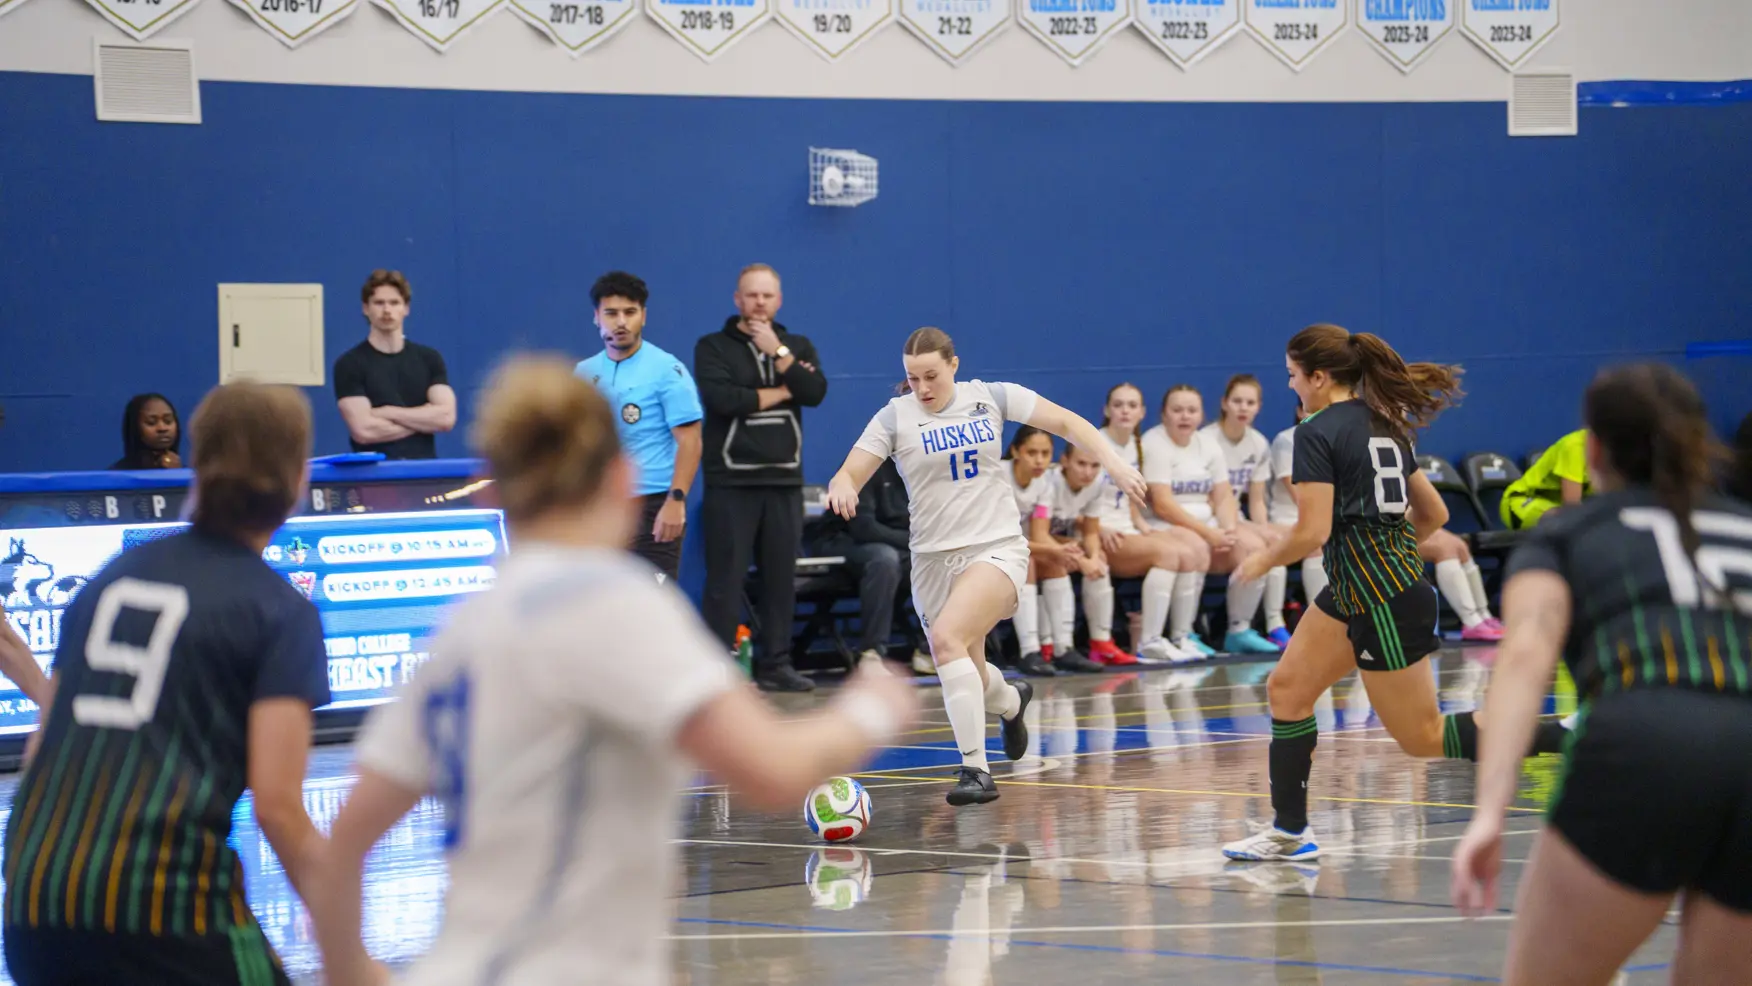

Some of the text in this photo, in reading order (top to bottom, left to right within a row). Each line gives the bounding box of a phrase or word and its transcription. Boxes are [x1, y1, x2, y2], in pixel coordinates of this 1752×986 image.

[418, 0, 460, 18] 16/17
[549, 3, 605, 25] 2017-18
[680, 10, 734, 31] 2018-19
[812, 14, 853, 33] 19/20
[937, 16, 973, 36] 21-22
[1048, 16, 1098, 36] 2022-23
[1161, 21, 1209, 40] 2022-23
[1273, 23, 1319, 41] 2023-24
[1382, 25, 1430, 43] 2023-24
[1489, 25, 1533, 43] 2023-24
[921, 418, 995, 455] HUSKIES
[949, 449, 980, 482] 15
[1367, 435, 1409, 514] 8
[105, 496, 119, 519] B
[152, 495, 167, 518] P
[322, 542, 385, 556] KICKOFF
[447, 538, 469, 549] AM
[328, 579, 391, 593] KICKOFF
[71, 574, 190, 731] 9
